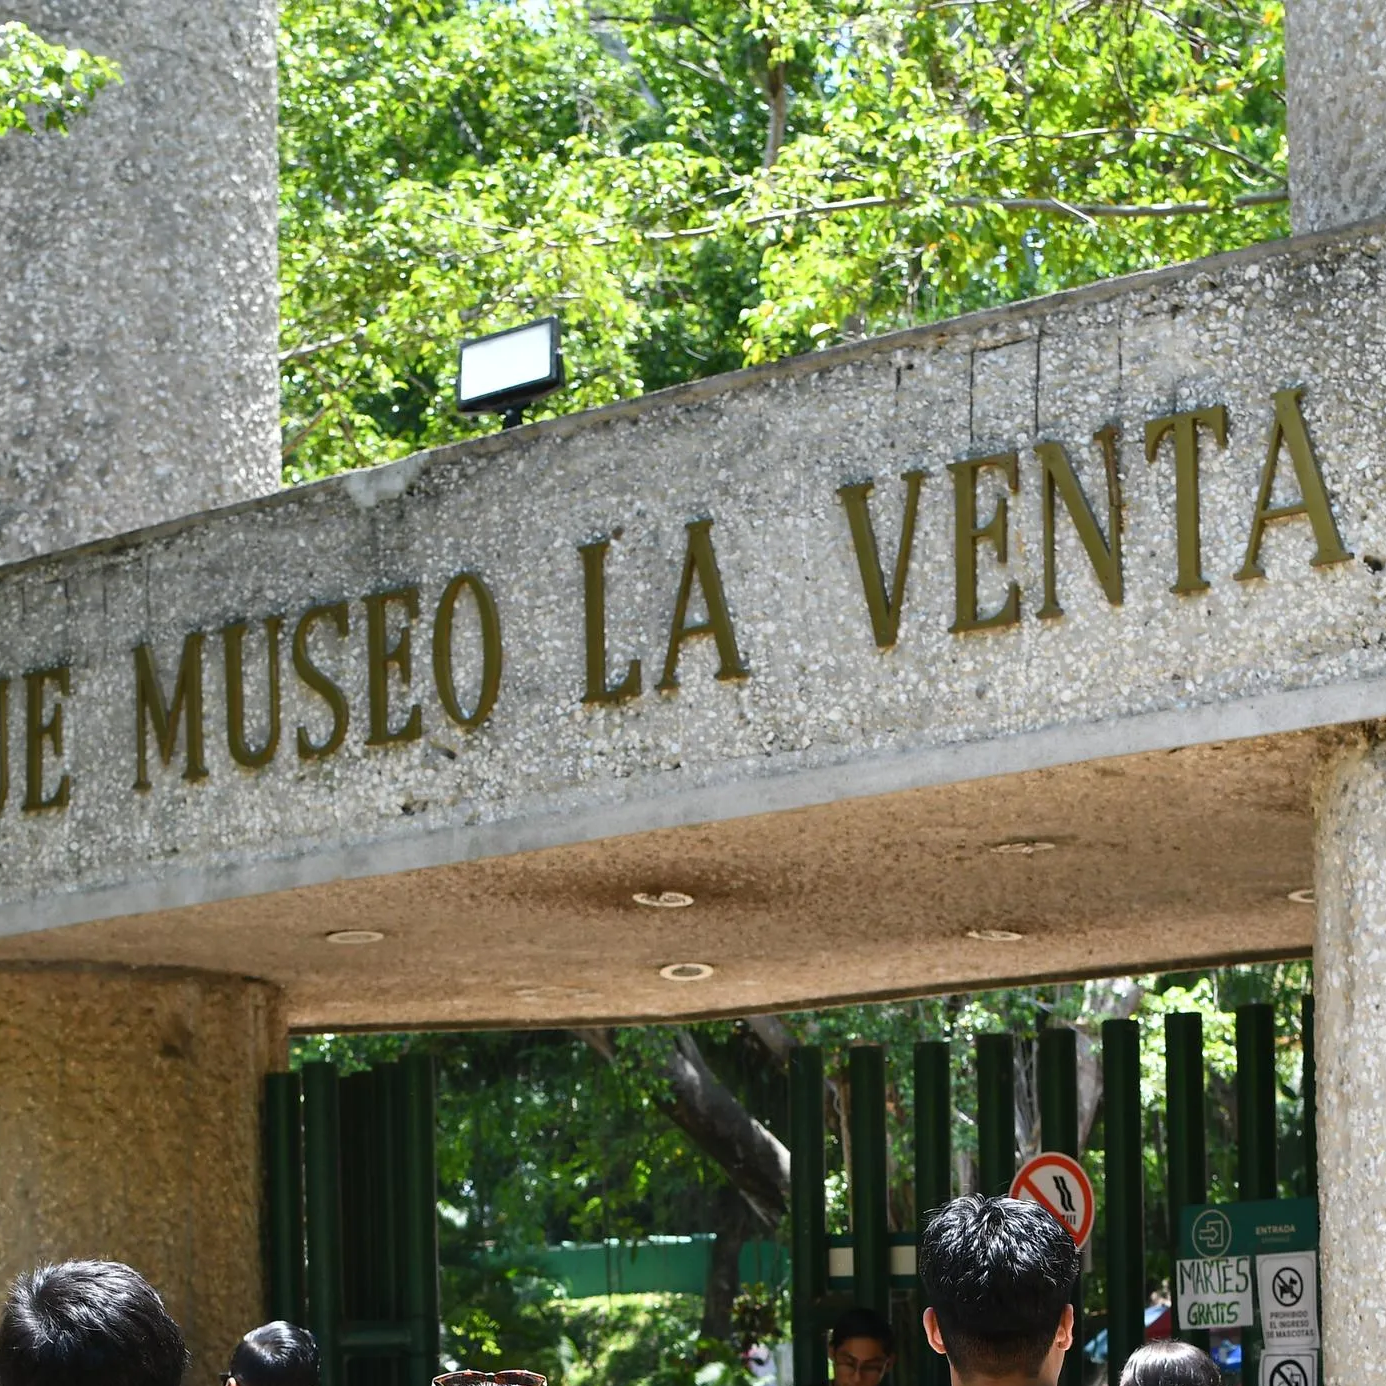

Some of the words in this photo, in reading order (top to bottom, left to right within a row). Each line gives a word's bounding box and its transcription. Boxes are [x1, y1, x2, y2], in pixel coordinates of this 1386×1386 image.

[131, 572, 503, 791] MUSEO
[577, 517, 749, 705] LA
[835, 387, 1355, 648] VENTA
[1255, 1224, 1296, 1235] ENTRADA
[1269, 1310, 1308, 1319] PROHIBIDO
[1269, 1321, 1277, 1329] EL
[1279, 1320, 1309, 1328] INGRESO
[1276, 1329, 1315, 1338] MASCOTAS
